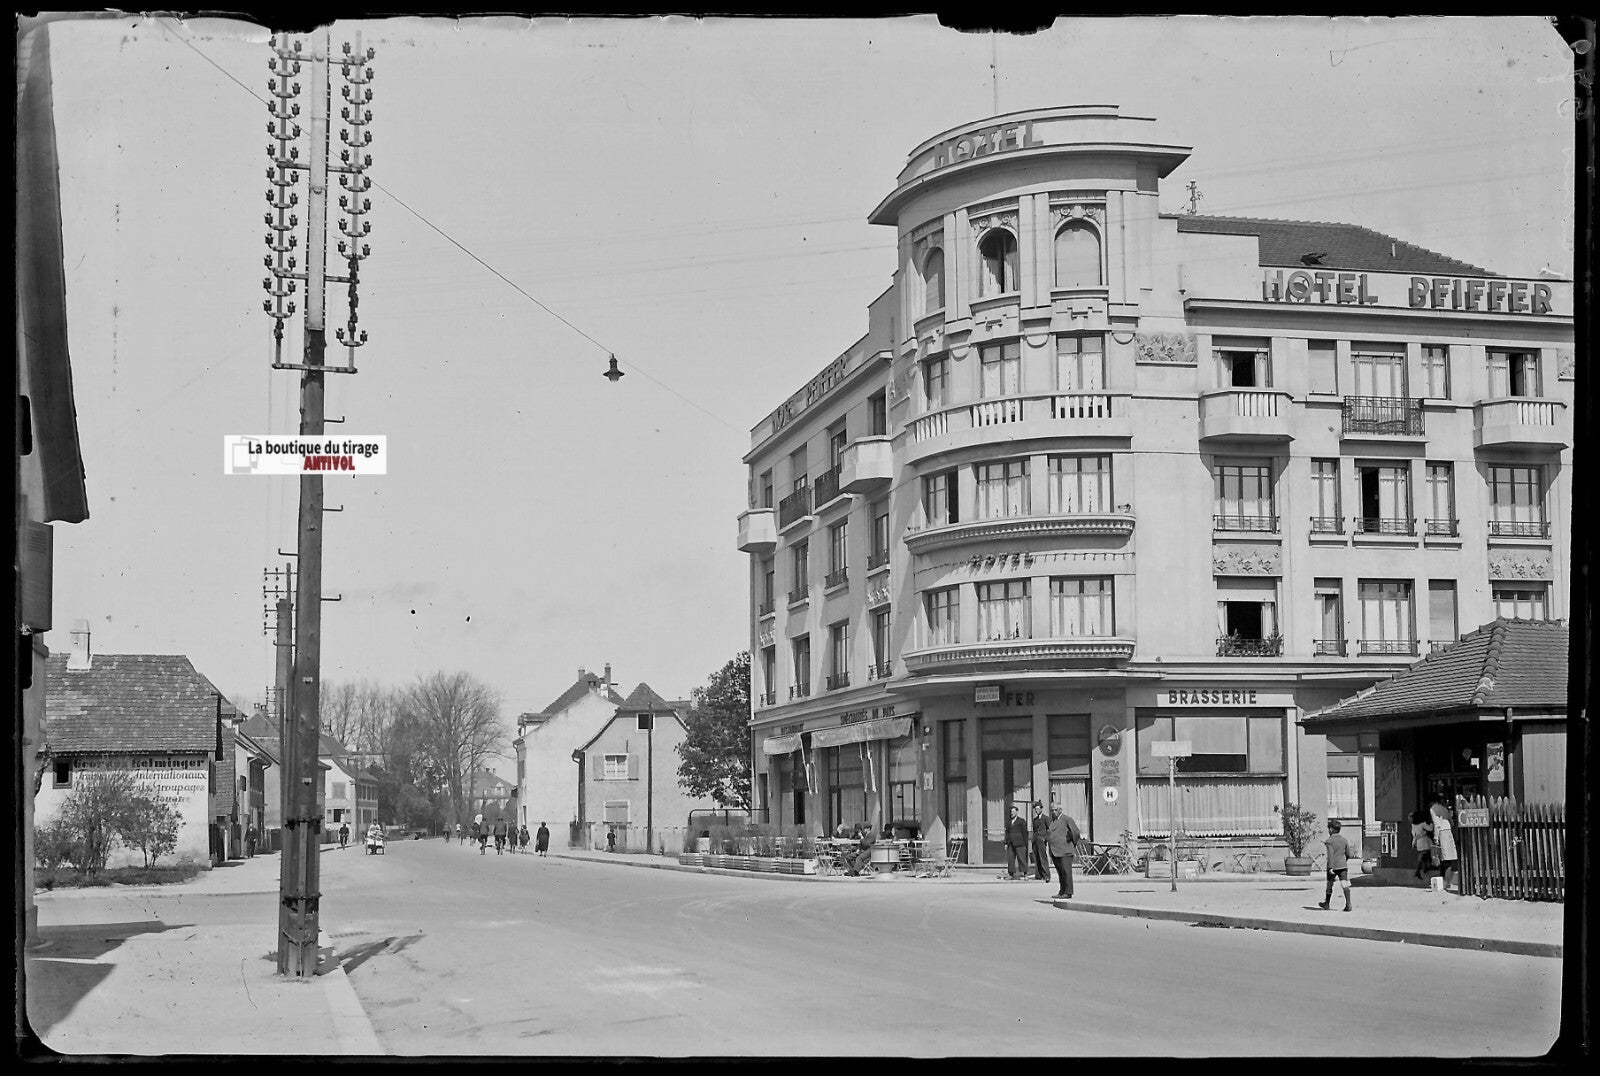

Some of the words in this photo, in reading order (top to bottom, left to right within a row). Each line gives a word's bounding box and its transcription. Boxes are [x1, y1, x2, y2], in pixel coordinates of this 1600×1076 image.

[934, 120, 1043, 168] HOTEL
[1263, 270, 1378, 304] HOTEL
[1168, 690, 1257, 704] BRASSERIE
